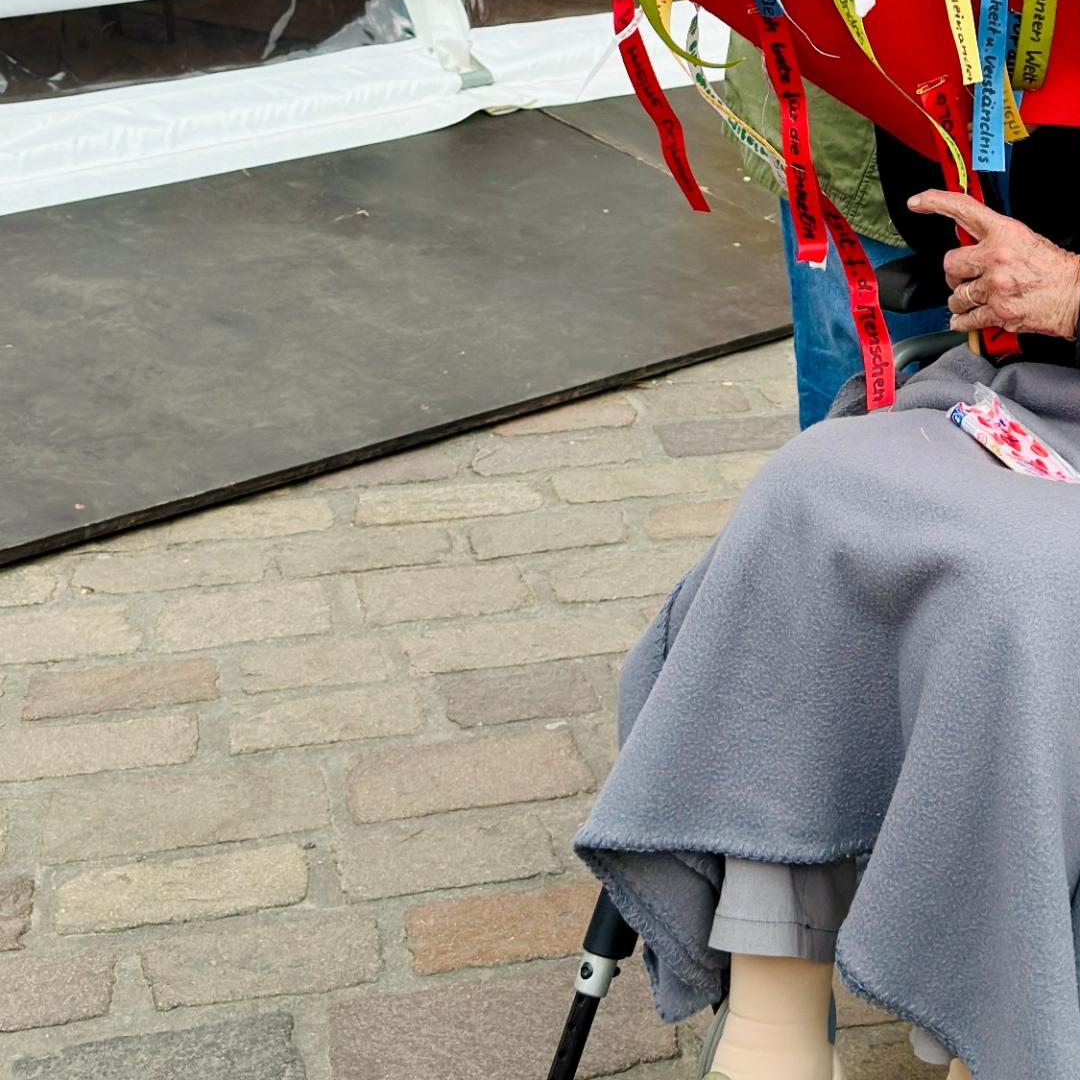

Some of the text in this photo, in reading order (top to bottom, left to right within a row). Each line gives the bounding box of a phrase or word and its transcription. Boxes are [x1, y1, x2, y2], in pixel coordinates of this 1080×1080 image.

[984, 39, 995, 55] u.
[1021, 48, 1045, 86] Welt
[857, 303, 888, 404] Menschen
